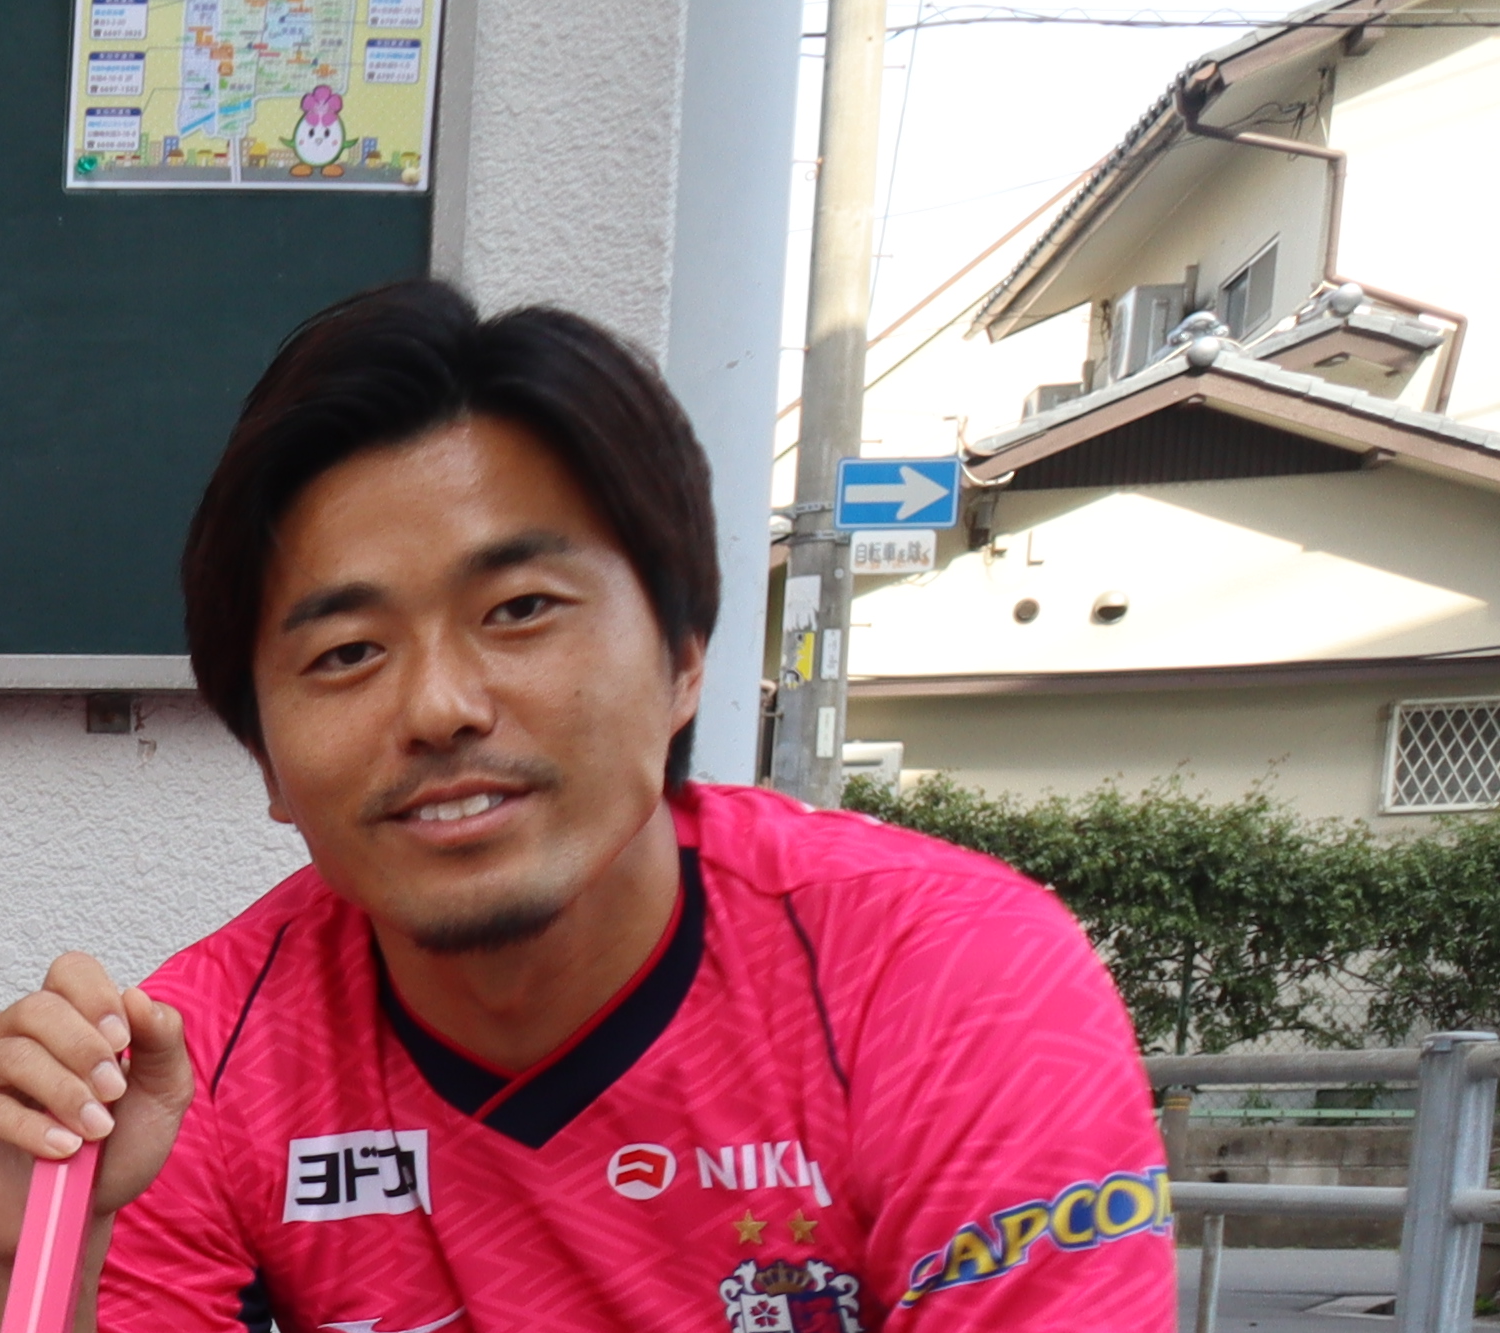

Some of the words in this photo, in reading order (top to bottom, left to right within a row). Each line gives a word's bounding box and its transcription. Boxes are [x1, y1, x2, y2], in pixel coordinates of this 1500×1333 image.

[855, 541, 932, 564] 自転車を除く
